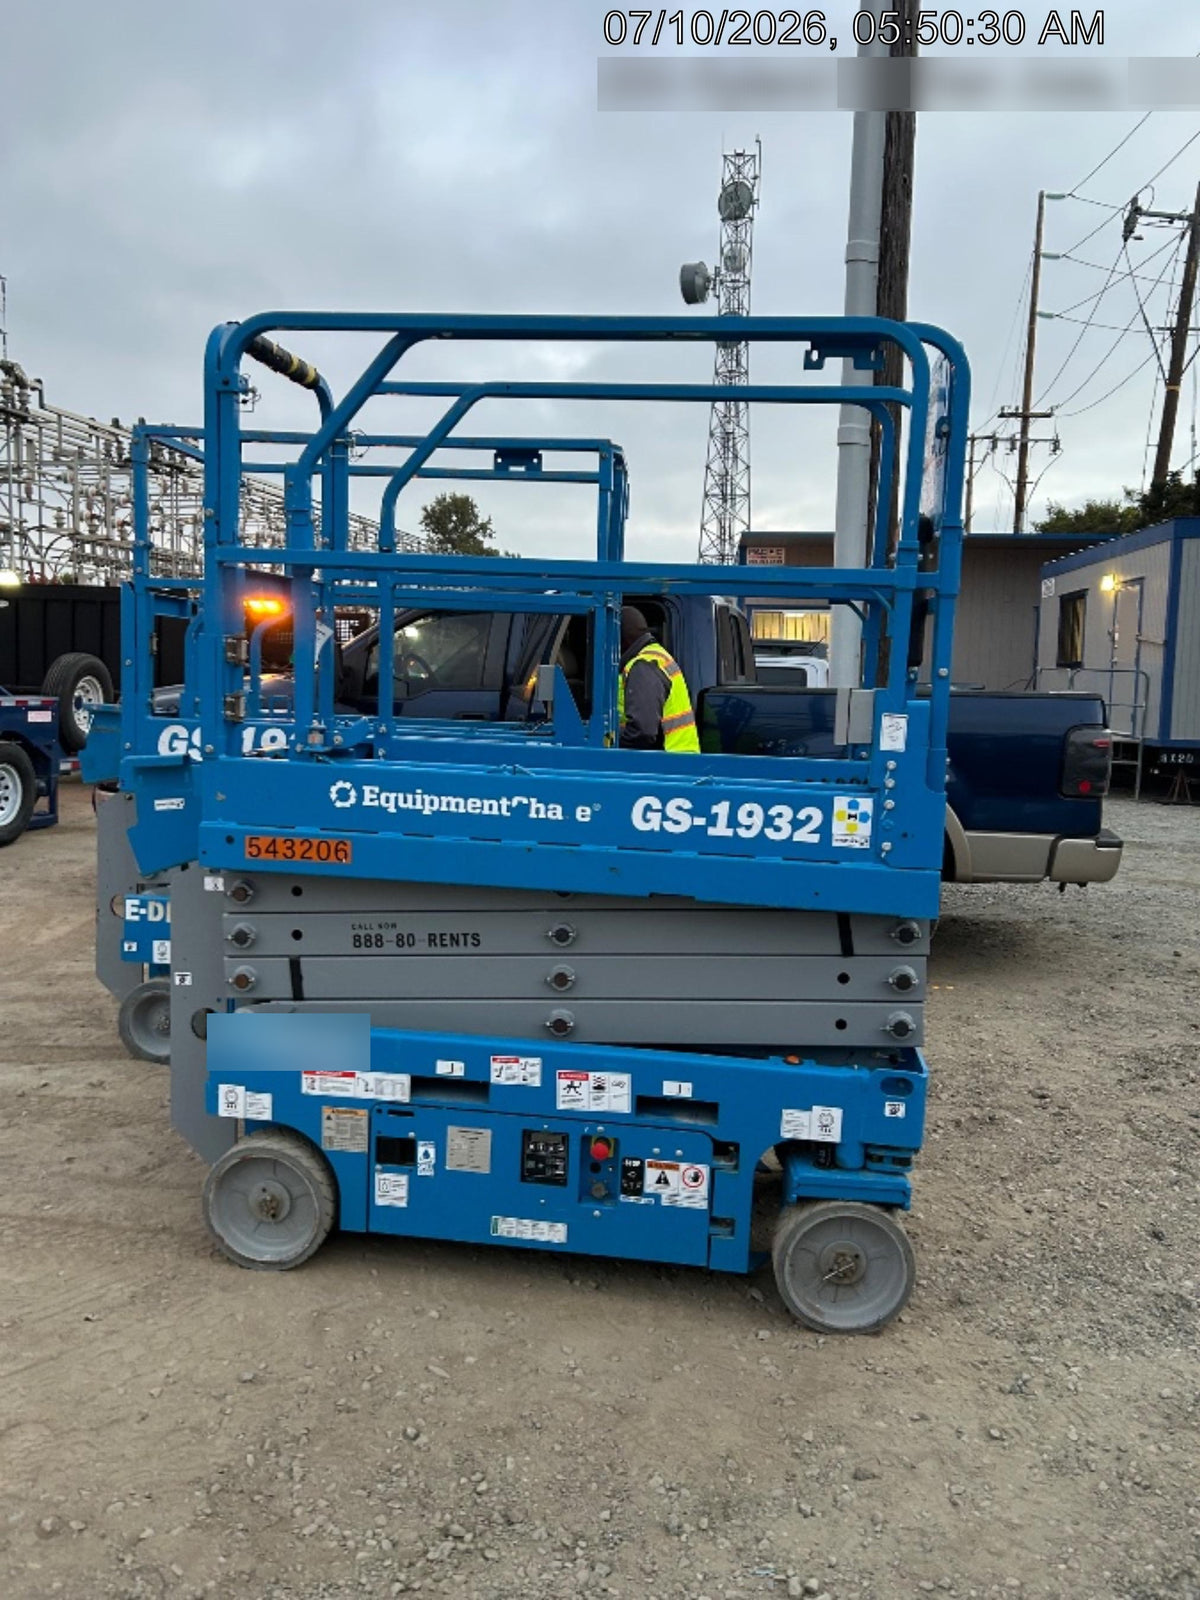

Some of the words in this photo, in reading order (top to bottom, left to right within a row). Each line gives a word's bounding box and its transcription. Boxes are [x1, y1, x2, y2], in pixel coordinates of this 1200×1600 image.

[631, 795, 823, 844] GS-1932
[247, 836, 349, 862] 543206
[351, 922, 374, 931] CALL
[377, 922, 397, 930] NOW
